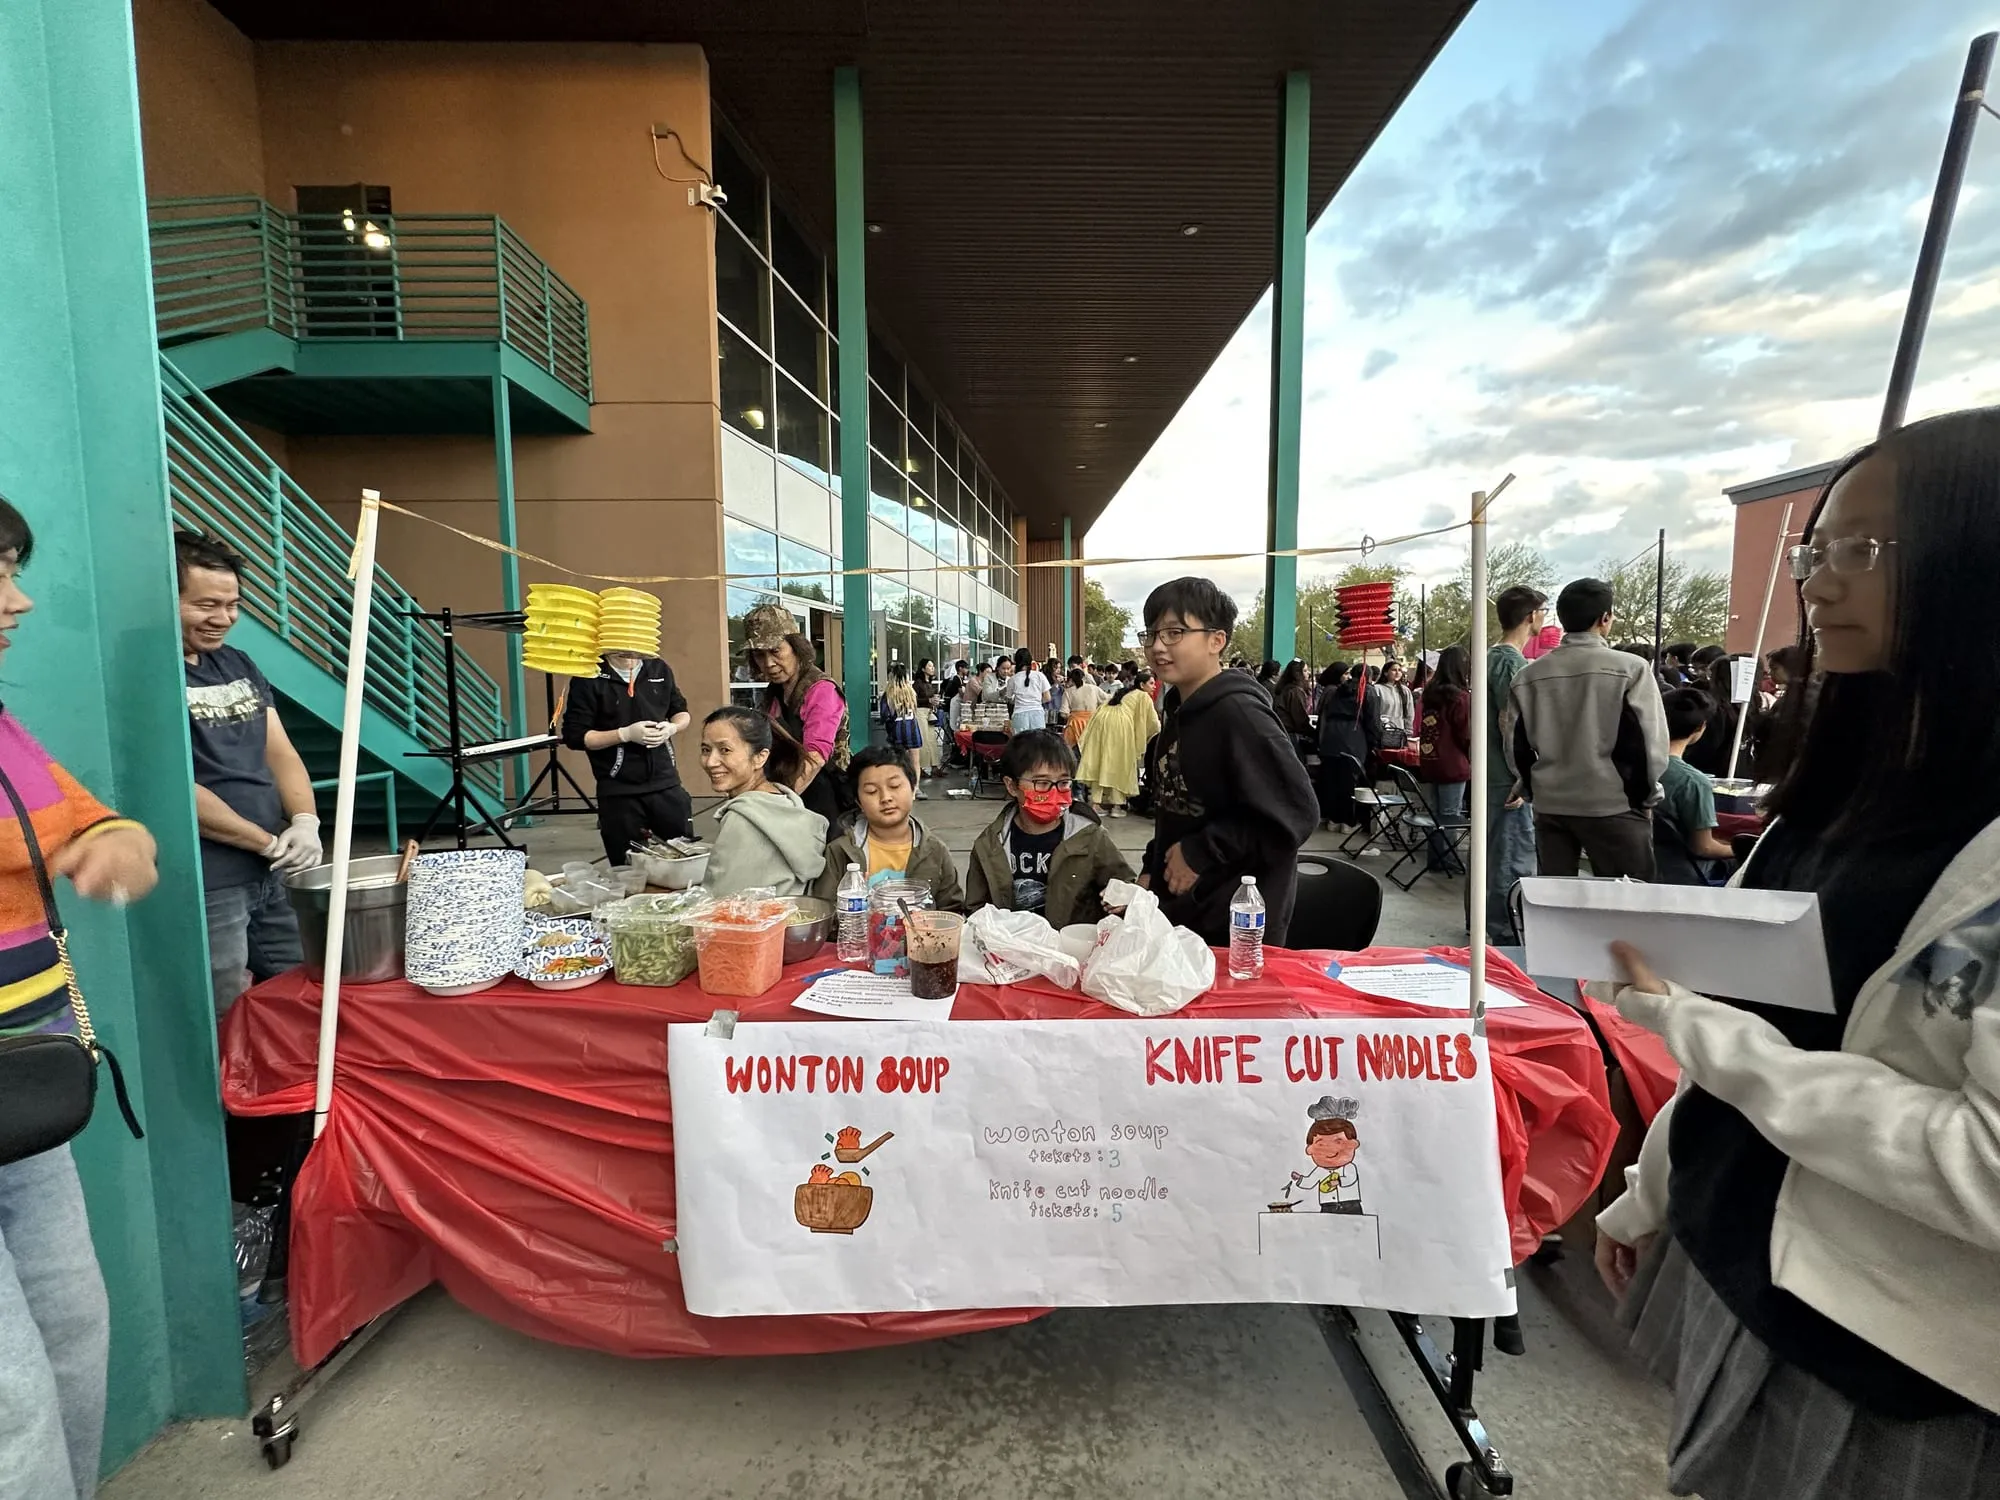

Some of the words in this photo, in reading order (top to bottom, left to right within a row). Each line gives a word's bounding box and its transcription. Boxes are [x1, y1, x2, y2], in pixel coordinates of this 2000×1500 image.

[1145, 1034, 1262, 1085] KNIFE
[1285, 1035, 1344, 1083] CUT
[1356, 1032, 1478, 1083] NOODLES
[725, 1055, 864, 1094] WONTON
[876, 1055, 950, 1094] SOUP
[984, 1119, 1096, 1145] wonton
[1110, 1123, 1169, 1151] soup
[1108, 1149, 1121, 1169] 3
[1055, 1178, 1092, 1199] cut
[1099, 1175, 1169, 1202] noodle
[1112, 1203, 1124, 1224] 5
